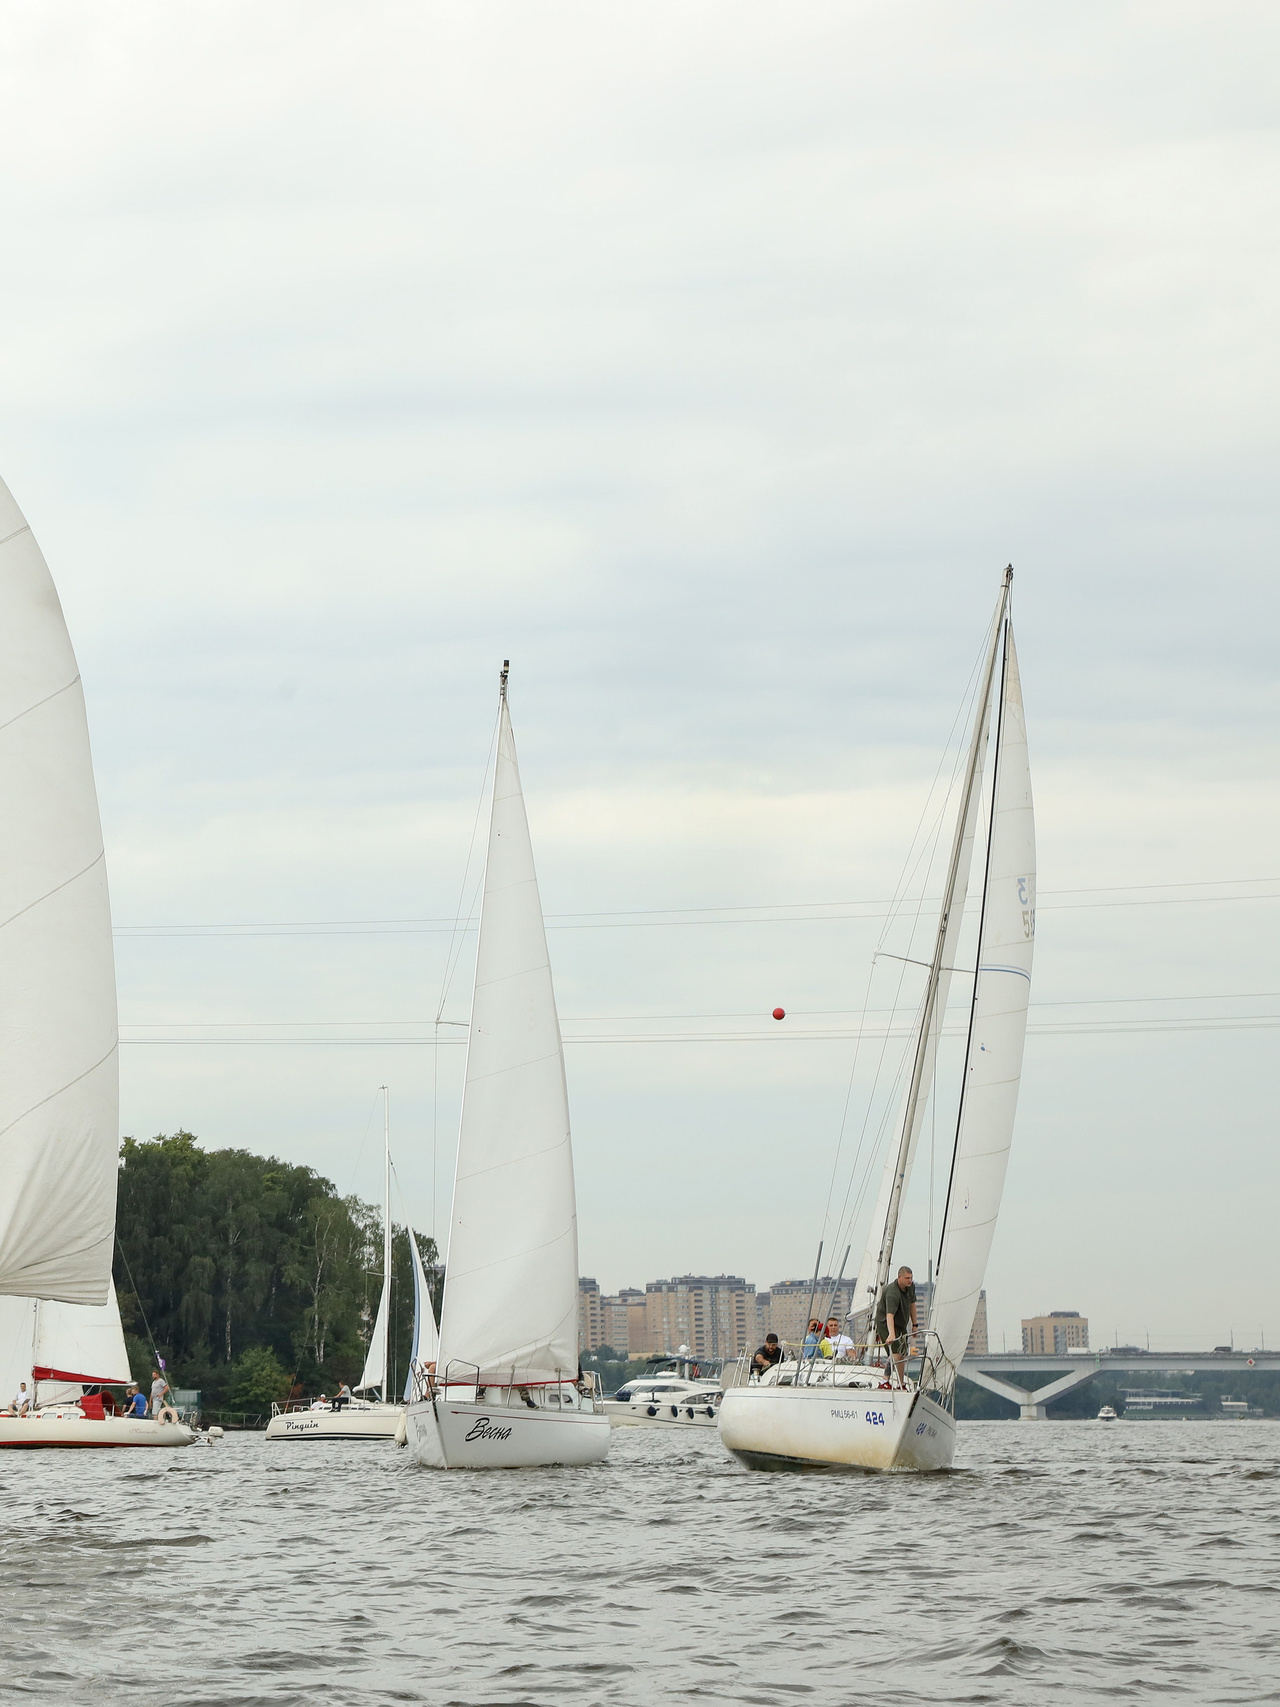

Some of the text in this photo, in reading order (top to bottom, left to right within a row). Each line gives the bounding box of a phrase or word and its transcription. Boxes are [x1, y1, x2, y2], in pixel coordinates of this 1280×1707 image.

[865, 1411, 885, 1426] 424
[285, 1420, 320, 1433] Pinguin
[464, 1416, 513, 1442] Весна
